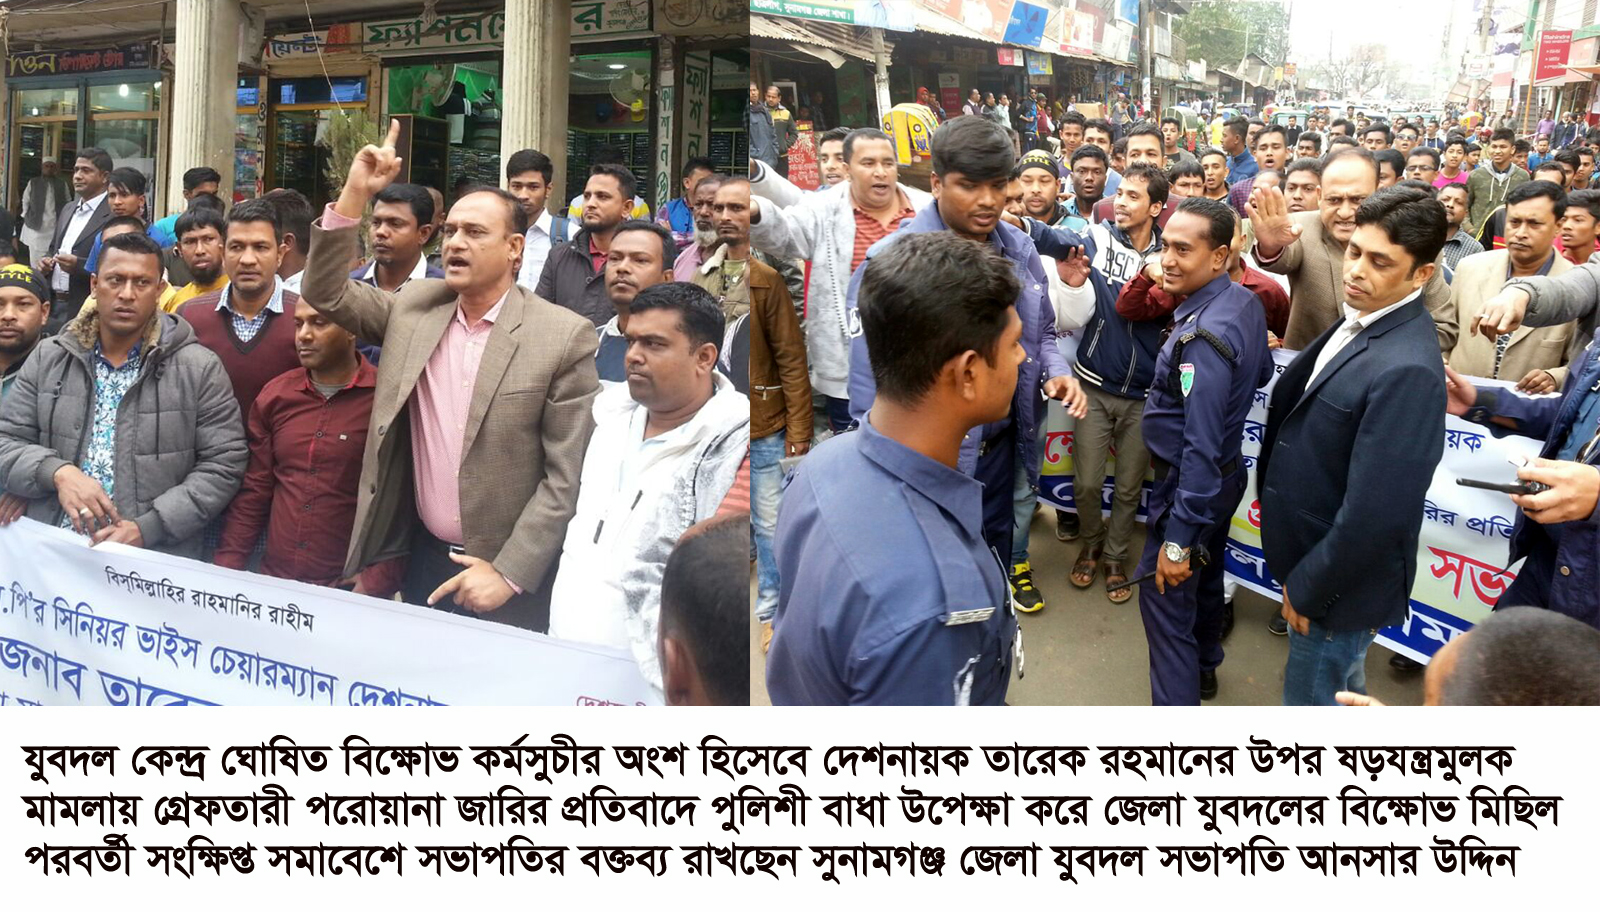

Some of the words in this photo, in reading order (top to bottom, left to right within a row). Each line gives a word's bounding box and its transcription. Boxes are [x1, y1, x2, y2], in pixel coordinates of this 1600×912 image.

[0, 271, 32, 284] TYLE
[1427, 545, 1518, 606] সভ
[190, 588, 263, 622] রাহমানির
[267, 602, 315, 633] রাহীম
[0, 636, 89, 701] জনাব
[52, 596, 130, 651] সিনিয়র
[136, 621, 203, 670] ভাইস
[210, 646, 340, 702] চেয়ারম্যান
